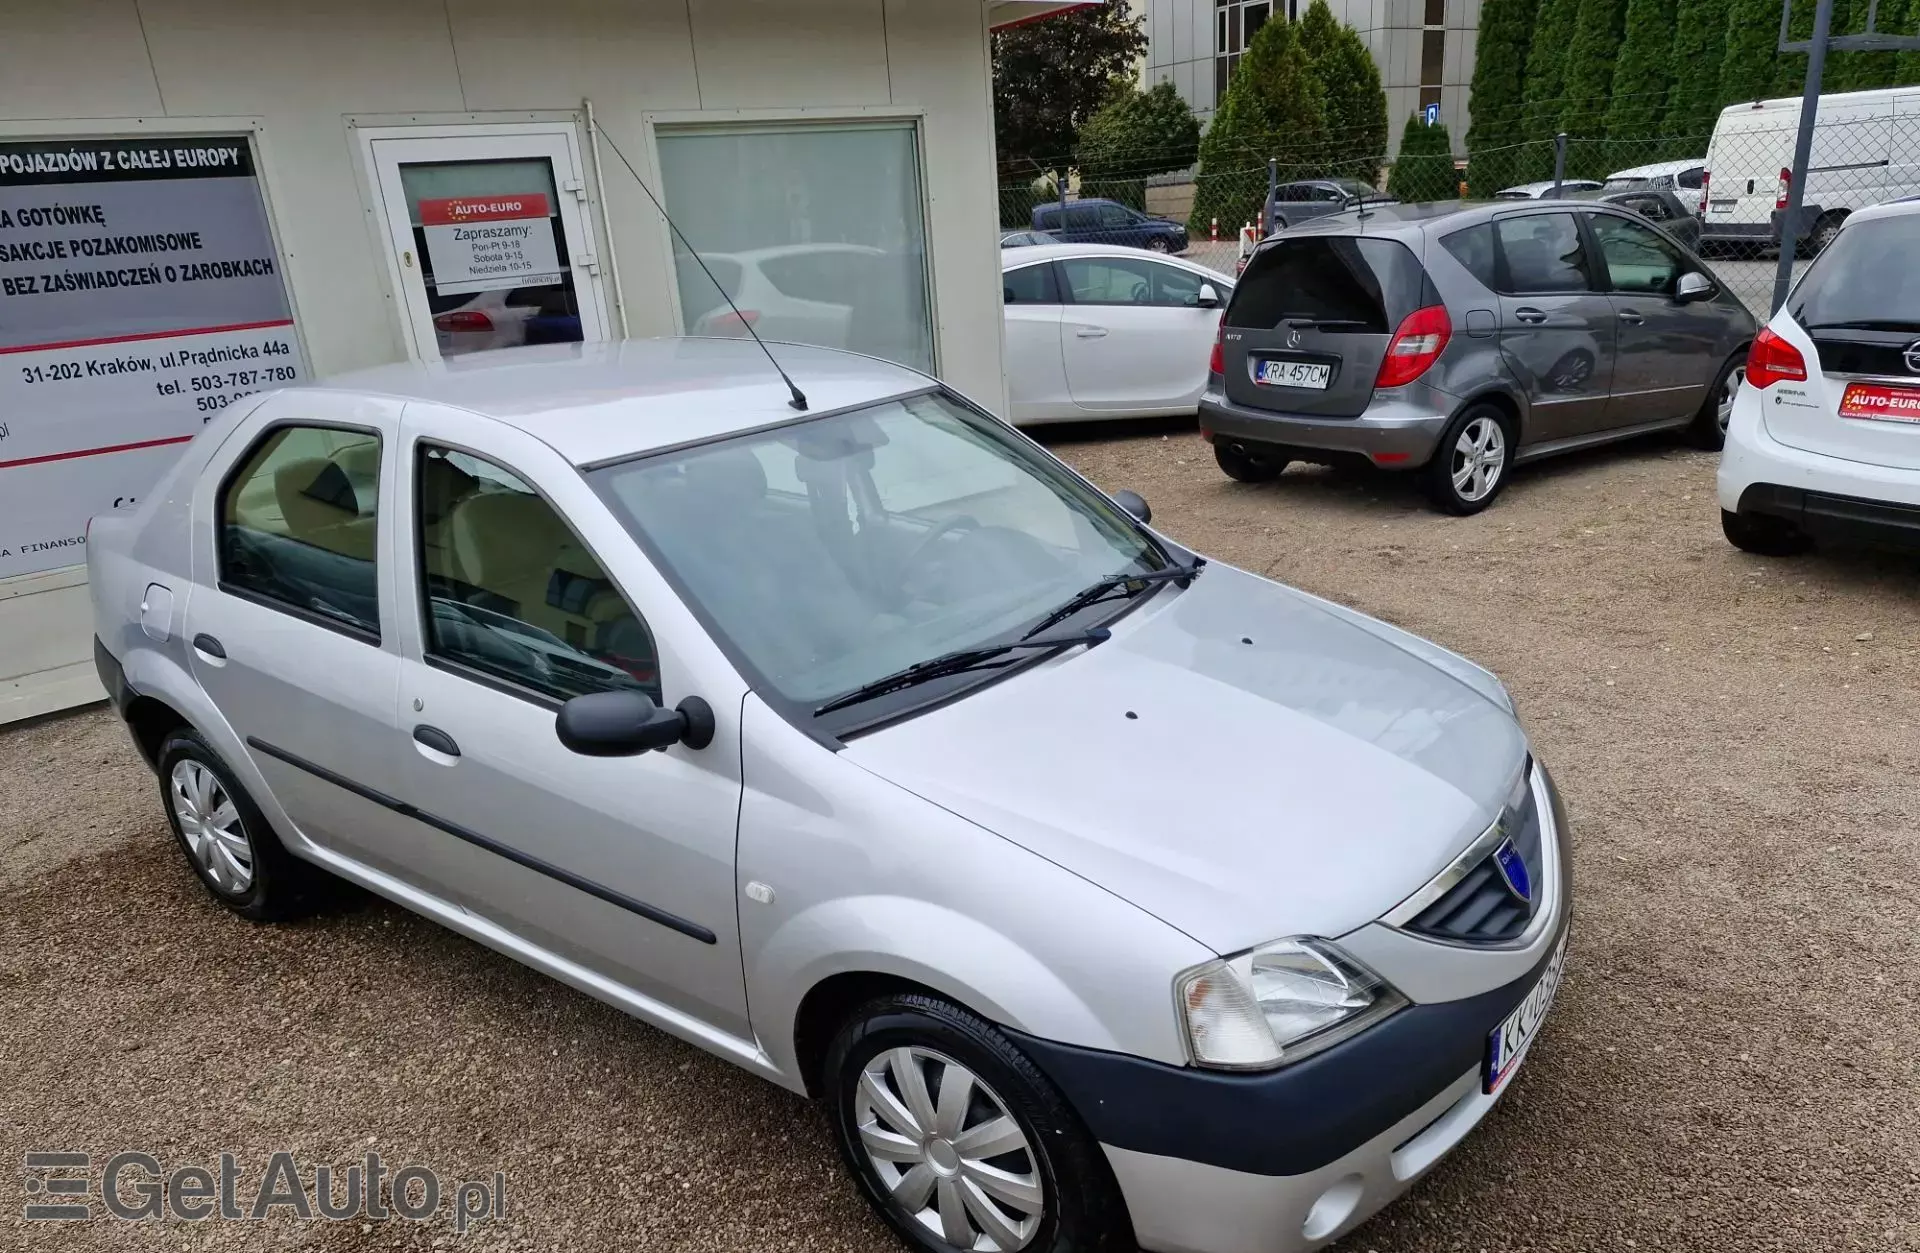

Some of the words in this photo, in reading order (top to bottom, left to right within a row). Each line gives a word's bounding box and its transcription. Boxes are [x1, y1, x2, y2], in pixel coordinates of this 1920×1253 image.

[0, 149, 98, 174] POJAZDÓW
[103, 151, 115, 170] Z
[117, 149, 171, 170] CAŁEJ
[175, 147, 239, 168] EUROPY
[17, 203, 107, 227] GOTÓWKĘ
[455, 201, 522, 215] AUTO-EURO
[70, 232, 202, 257] POZAKOMISOWE
[453, 226, 533, 241] Zapraszamy:
[468, 265, 508, 275] Niedziela
[510, 262, 532, 271] 10-15
[473, 254, 503, 263] Sobota
[504, 252, 523, 261] 9-15
[2, 276, 40, 296] BEZ
[40, 263, 161, 293] ZAŚWIADCZEŃ
[165, 265, 177, 283] O
[179, 258, 275, 282] ZAROBKACH
[22, 362, 84, 384] 31-202
[86, 355, 156, 378] Kraków,
[159, 342, 259, 370] ul.Prądnicka
[262, 340, 290, 357] 44a
[1264, 363, 1286, 380] KRA
[1290, 365, 1329, 383] 457CM
[156, 380, 186, 396] tel.
[191, 366, 297, 392] 503-787-780
[1503, 997, 1530, 1062] KK
